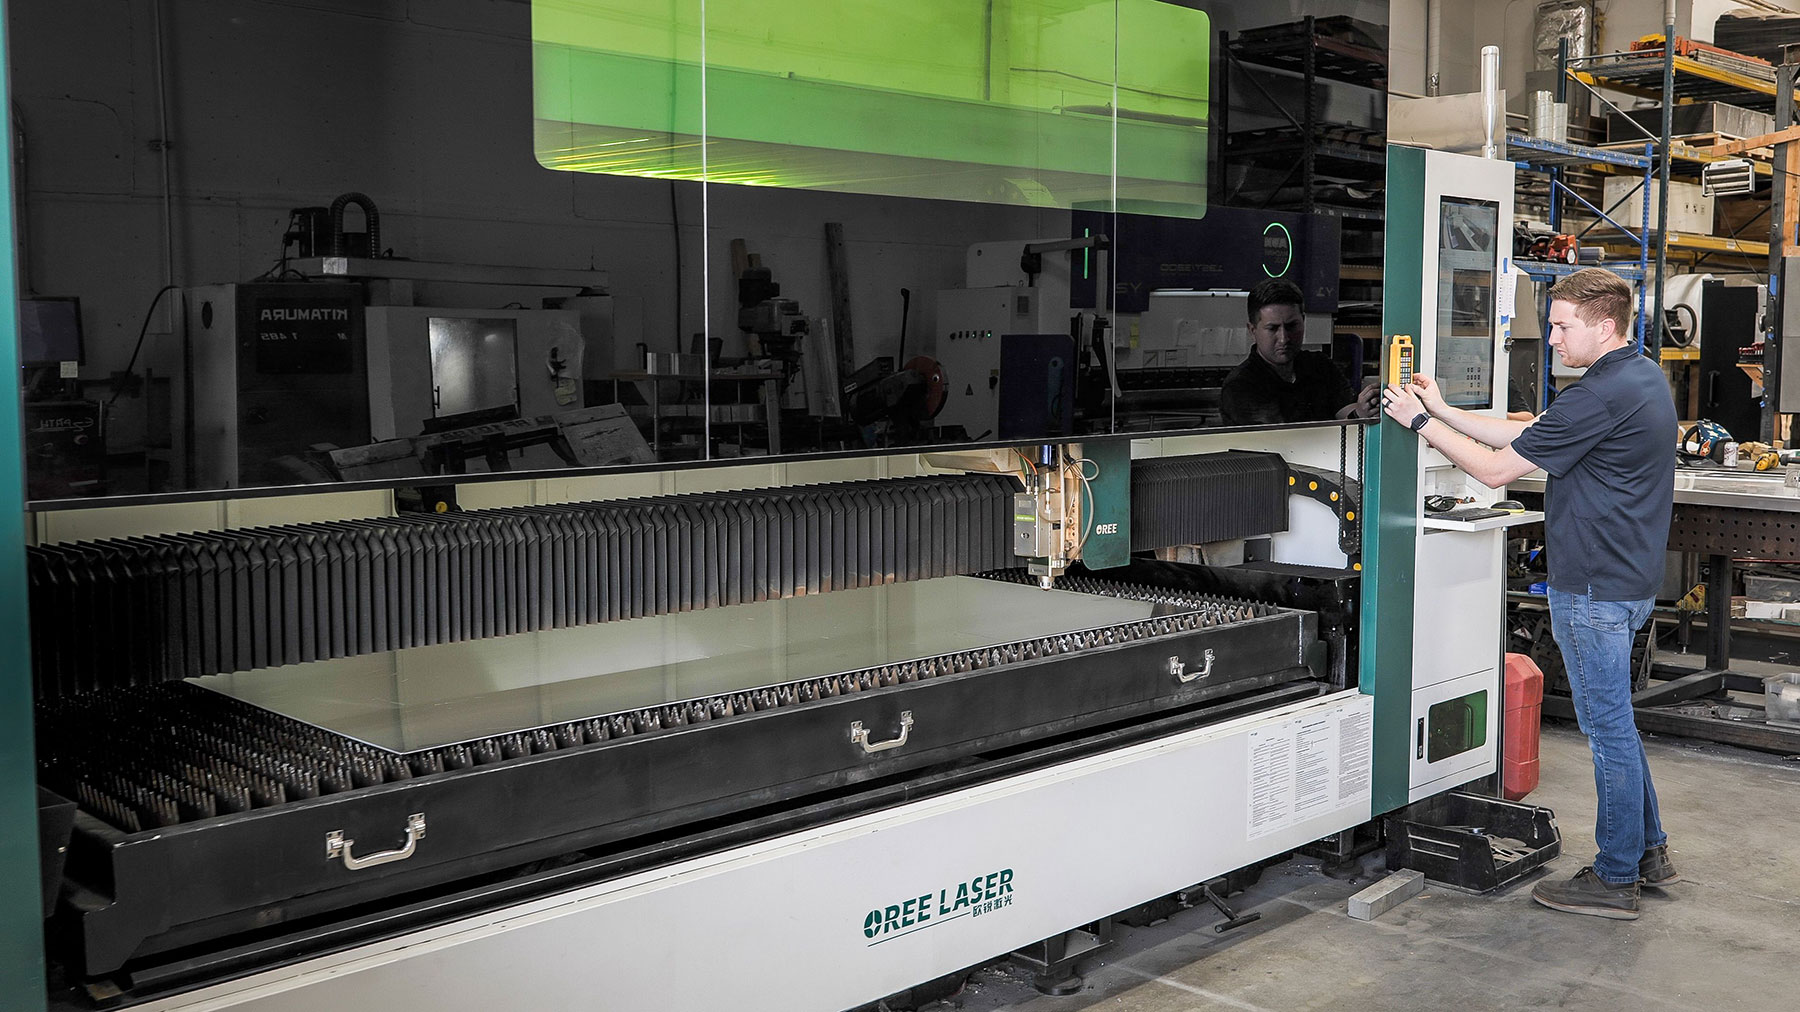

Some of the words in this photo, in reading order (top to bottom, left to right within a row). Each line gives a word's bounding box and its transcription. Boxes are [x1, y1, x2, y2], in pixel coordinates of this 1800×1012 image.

[1095, 523, 1118, 535] OREE
[863, 893, 933, 939] OREE
[939, 868, 1014, 916] LASER
